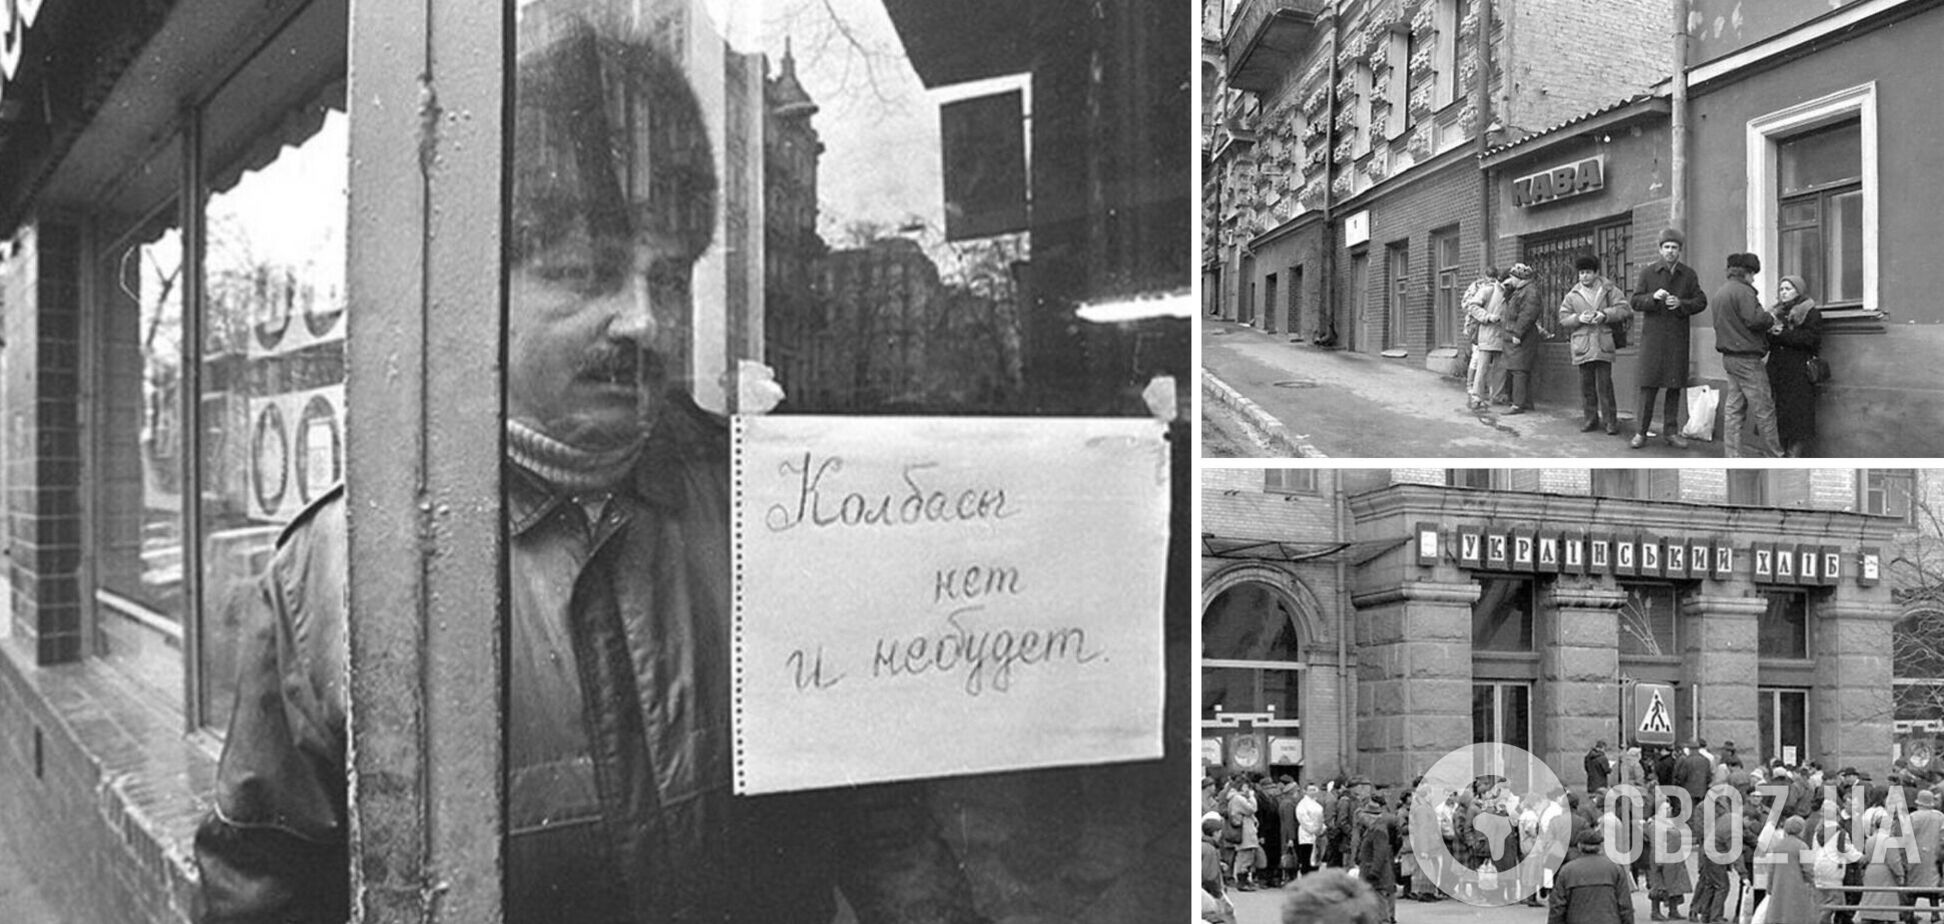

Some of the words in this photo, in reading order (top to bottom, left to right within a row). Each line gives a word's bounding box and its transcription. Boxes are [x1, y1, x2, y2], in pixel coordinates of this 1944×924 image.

[1511, 157, 1603, 208] КАВА
[765, 452, 1022, 533] Колбасы
[934, 565, 1024, 603] нет
[1757, 550, 1838, 577] ХЛІБ
[785, 643, 847, 689] и
